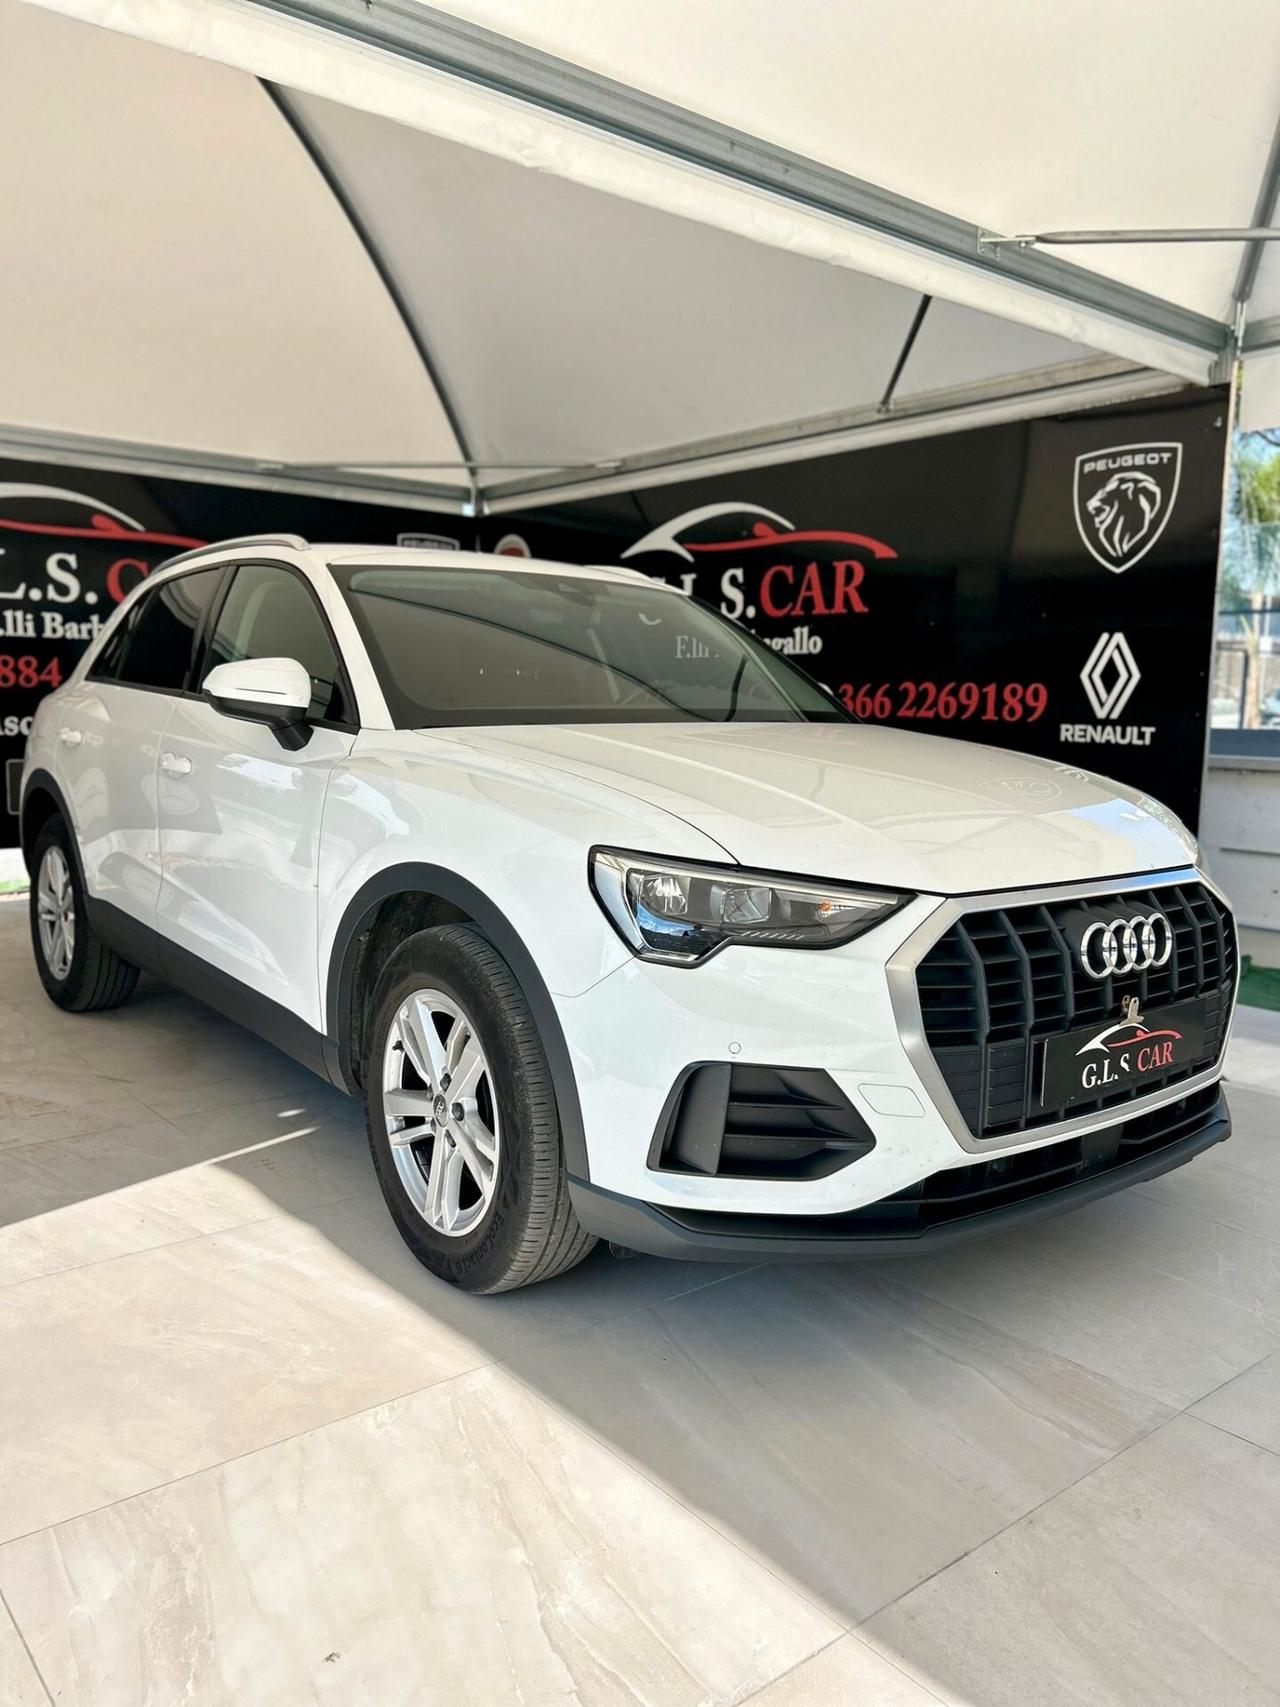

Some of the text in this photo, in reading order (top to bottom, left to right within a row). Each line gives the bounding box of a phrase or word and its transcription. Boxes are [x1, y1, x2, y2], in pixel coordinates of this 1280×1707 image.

[1083, 452, 1173, 475] PEUGEOT
[760, 560, 868, 618] CAR
[839, 681, 1048, 722] 366 2269189
[1059, 723, 1156, 746] RENAULT
[1136, 1041, 1174, 1072] CAR
